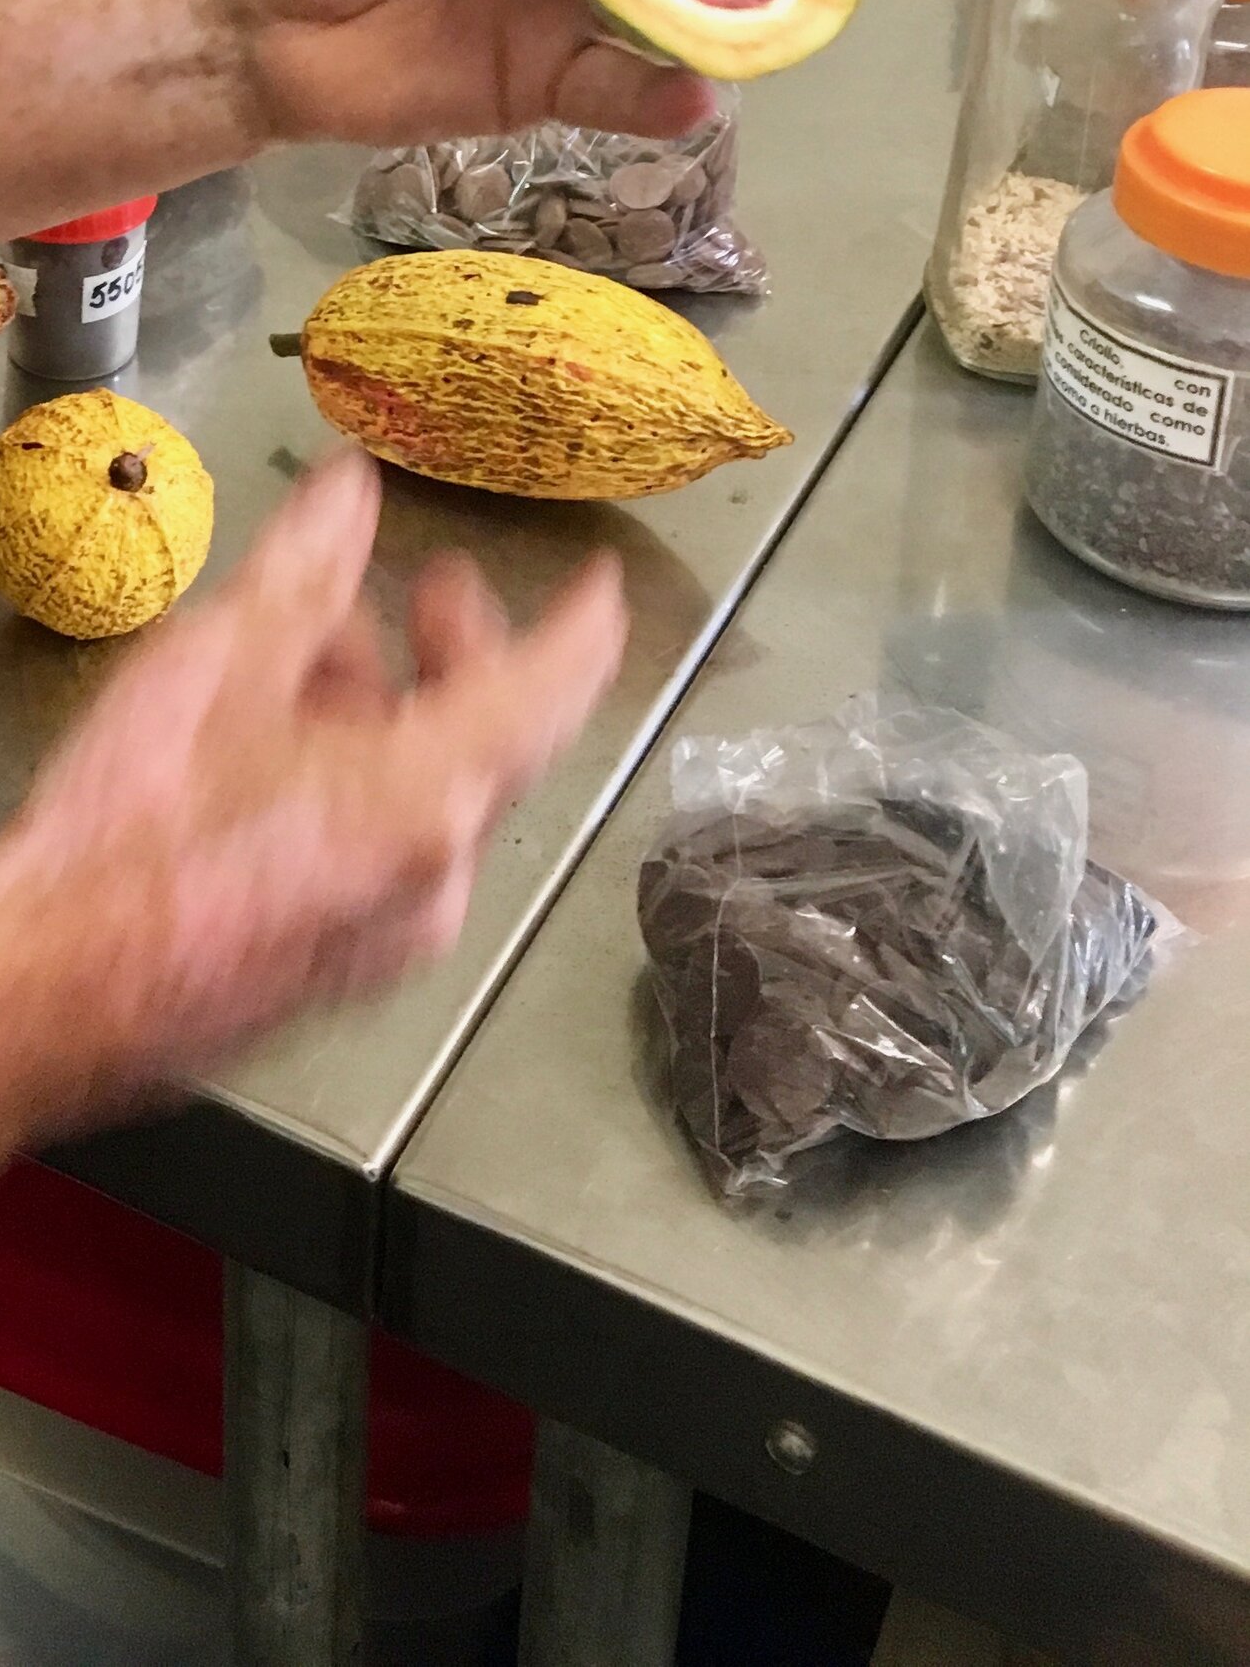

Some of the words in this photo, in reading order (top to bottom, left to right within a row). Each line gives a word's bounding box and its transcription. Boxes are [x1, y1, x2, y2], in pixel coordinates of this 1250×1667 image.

[1055, 351, 1134, 413] considerado
[1150, 412, 1205, 436] como
[1067, 342, 1174, 408] características
[1183, 401, 1208, 417] de
[1079, 329, 1124, 369] Criollo.
[1174, 379, 1211, 398] con
[1104, 408, 1169, 447] hierbas.
